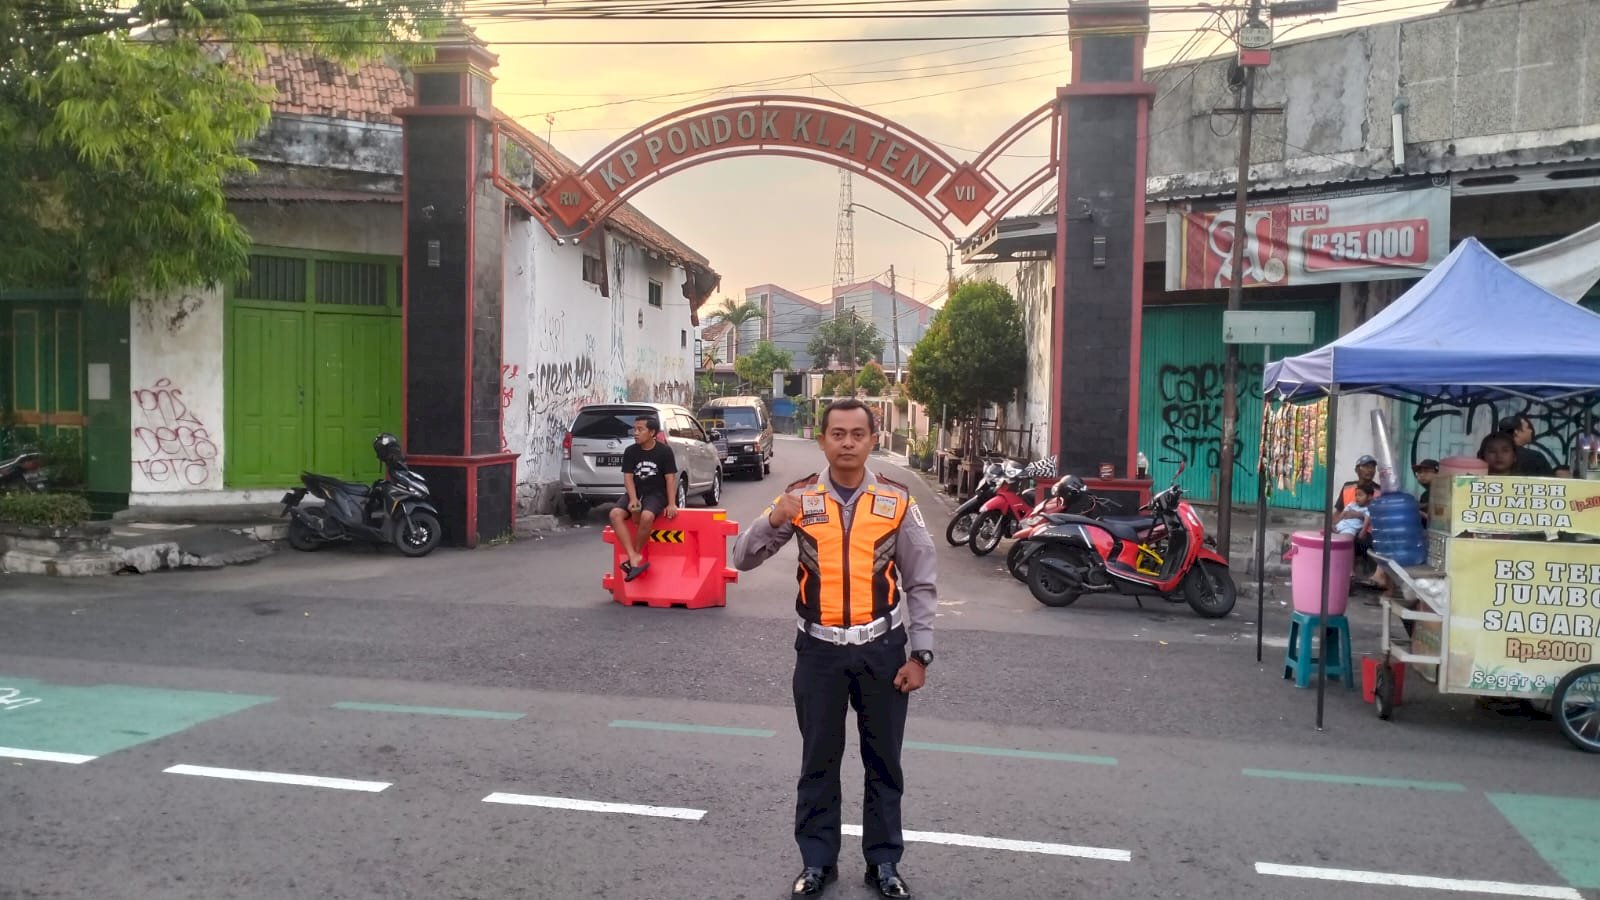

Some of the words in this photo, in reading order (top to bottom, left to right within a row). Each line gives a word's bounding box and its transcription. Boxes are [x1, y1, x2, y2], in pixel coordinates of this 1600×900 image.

[599, 150, 638, 192] KP
[645, 110, 780, 165] PONDOK
[791, 111, 931, 187] KLATEN
[560, 192, 580, 206] RW
[954, 185, 976, 201] VII
[1290, 206, 1328, 222] NEW
[1330, 226, 1415, 260] 35.000
[1470, 482, 1503, 495] ES
[1512, 483, 1566, 497] TEH
[1470, 495, 1566, 511] JUMBO
[1462, 510, 1572, 528] SAGARA
[1494, 560, 1534, 581] ES
[1484, 609, 1600, 637] SAGAR
[1506, 637, 1592, 663] Rp.3000
[1473, 671, 1529, 689] Segar
[1534, 675, 1546, 688] &
